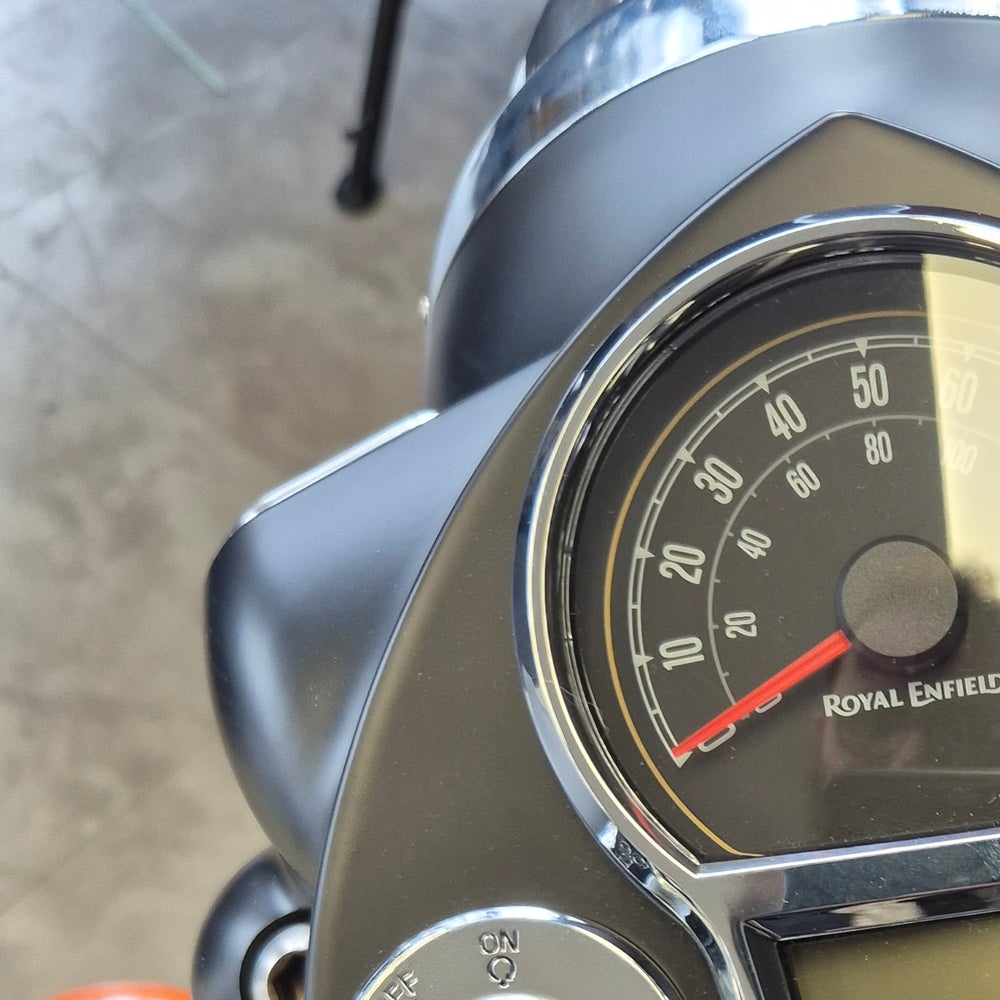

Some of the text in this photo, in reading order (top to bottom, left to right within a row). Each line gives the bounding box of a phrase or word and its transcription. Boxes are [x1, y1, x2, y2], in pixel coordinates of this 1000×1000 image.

[850, 362, 889, 408] 50
[941, 366, 979, 414] 60
[764, 392, 807, 440] 40
[864, 431, 893, 465] 80
[943, 441, 978, 475] 100
[694, 456, 743, 504] 30
[786, 461, 820, 498] 60
[736, 527, 772, 560] 40
[660, 543, 706, 585] 20
[724, 611, 757, 640] 20
[660, 635, 704, 671] 10
[822, 686, 904, 717] ROYAL
[478, 928, 520, 955] ON
